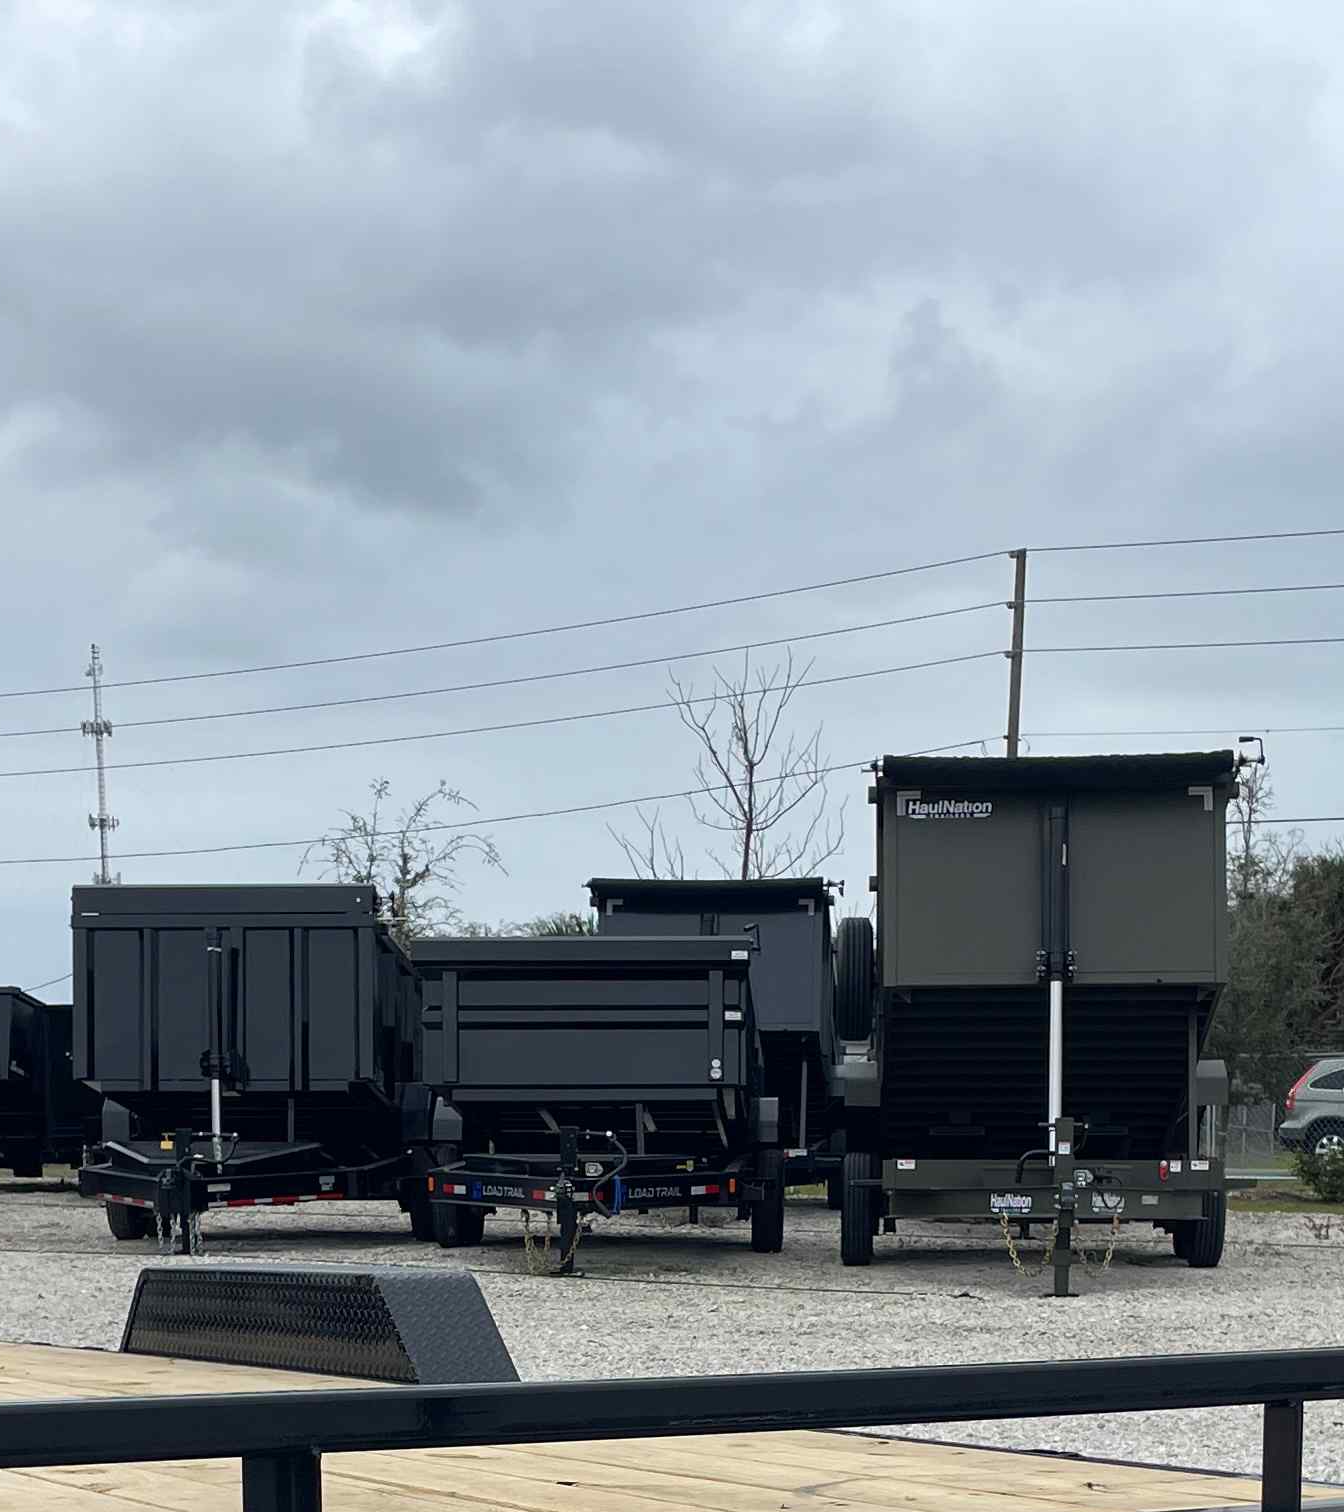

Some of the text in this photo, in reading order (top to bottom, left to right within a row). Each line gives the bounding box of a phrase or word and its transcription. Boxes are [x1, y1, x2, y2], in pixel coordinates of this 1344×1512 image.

[907, 799, 994, 815] HaulNation
[482, 1185, 505, 1196] LOAD
[628, 1186, 683, 1199] LOAD TRAIL
